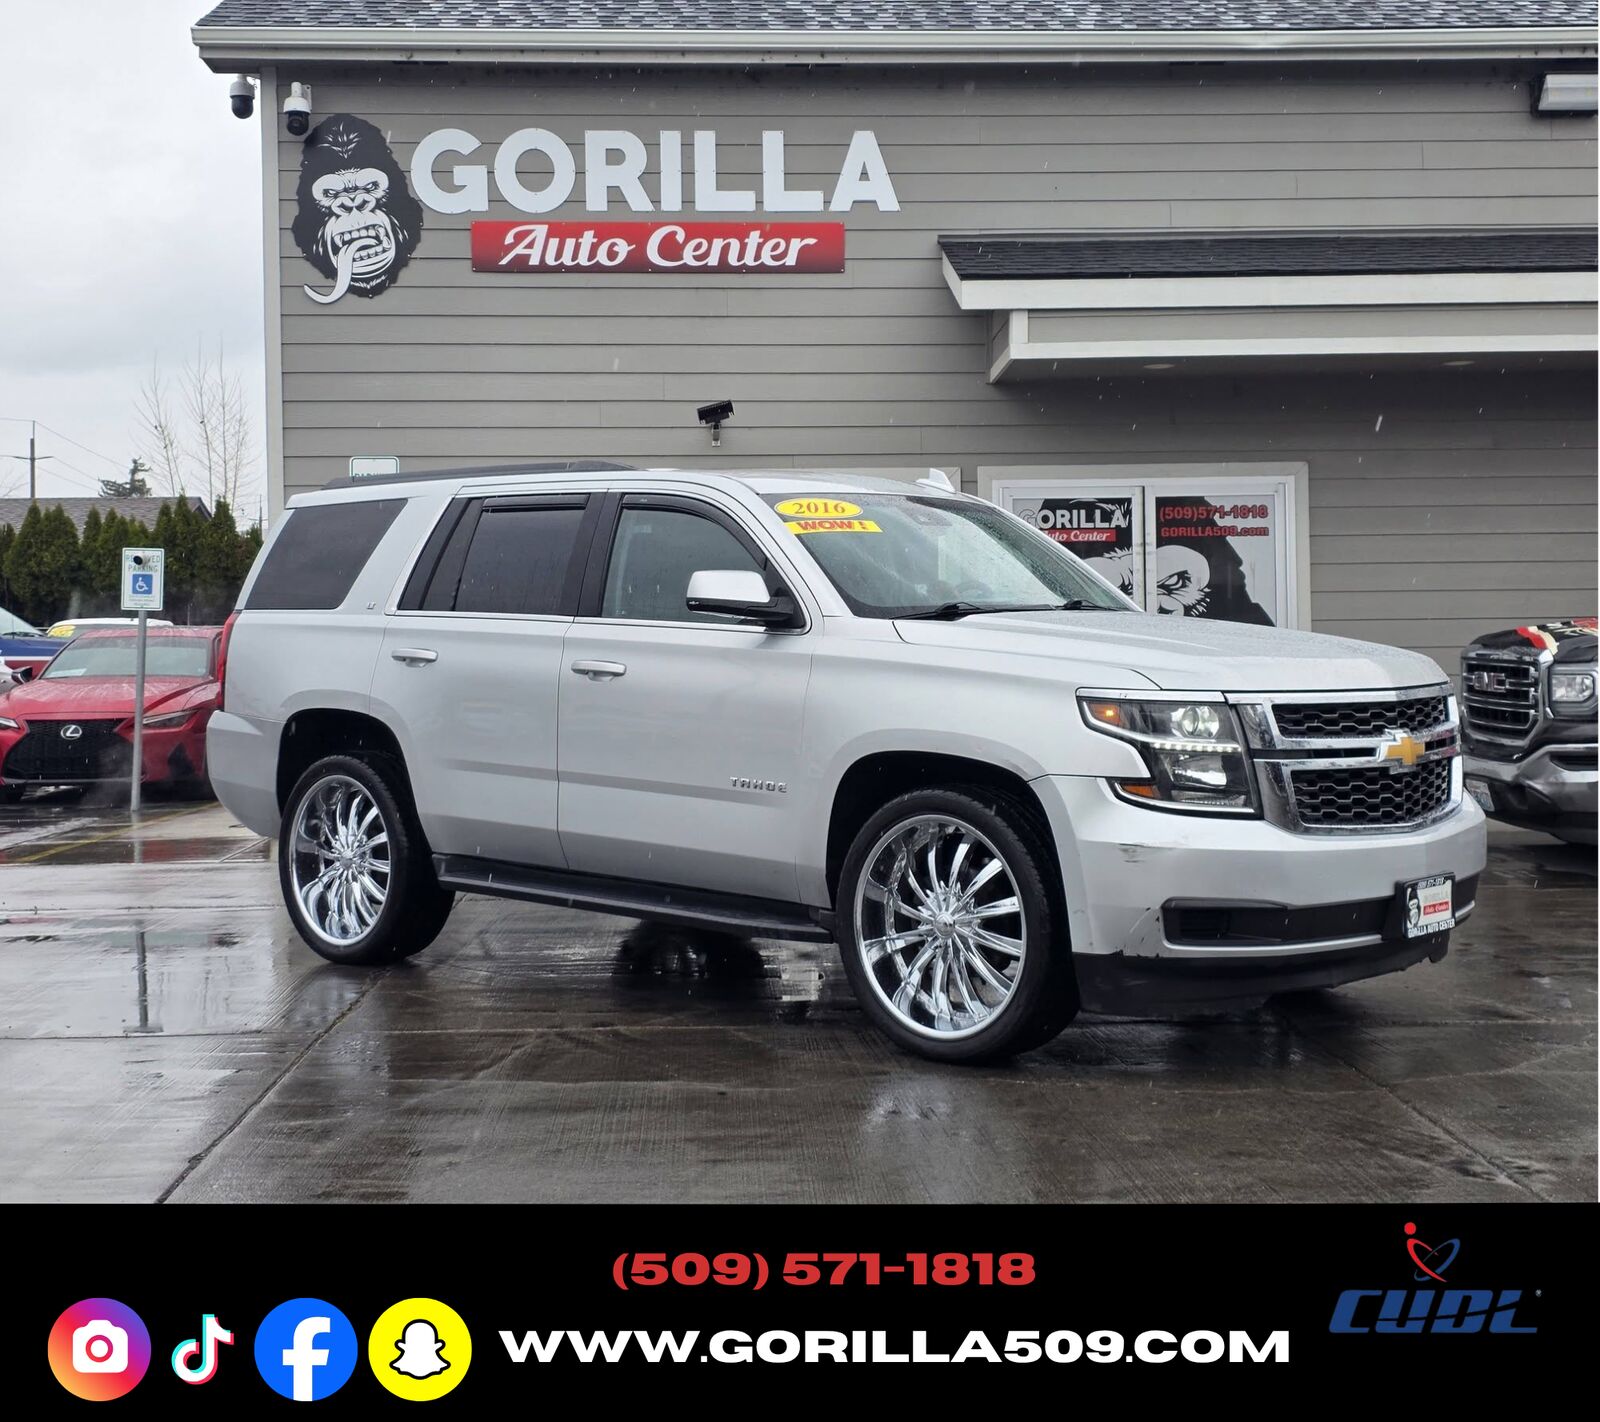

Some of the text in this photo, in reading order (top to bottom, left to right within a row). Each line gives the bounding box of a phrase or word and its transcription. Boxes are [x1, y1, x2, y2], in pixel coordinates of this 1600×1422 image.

[410, 128, 901, 214] GORILLA
[499, 224, 817, 267] Auto Center
[792, 502, 846, 514] 2016
[1160, 505, 1269, 522] (509)571-1818
[1018, 508, 1127, 530] GORILLA
[1070, 530, 1111, 541] Center
[1161, 526, 1270, 537] GORILLA509.com
[1473, 671, 1506, 693] GMC
[729, 776, 788, 794] TAHOE
